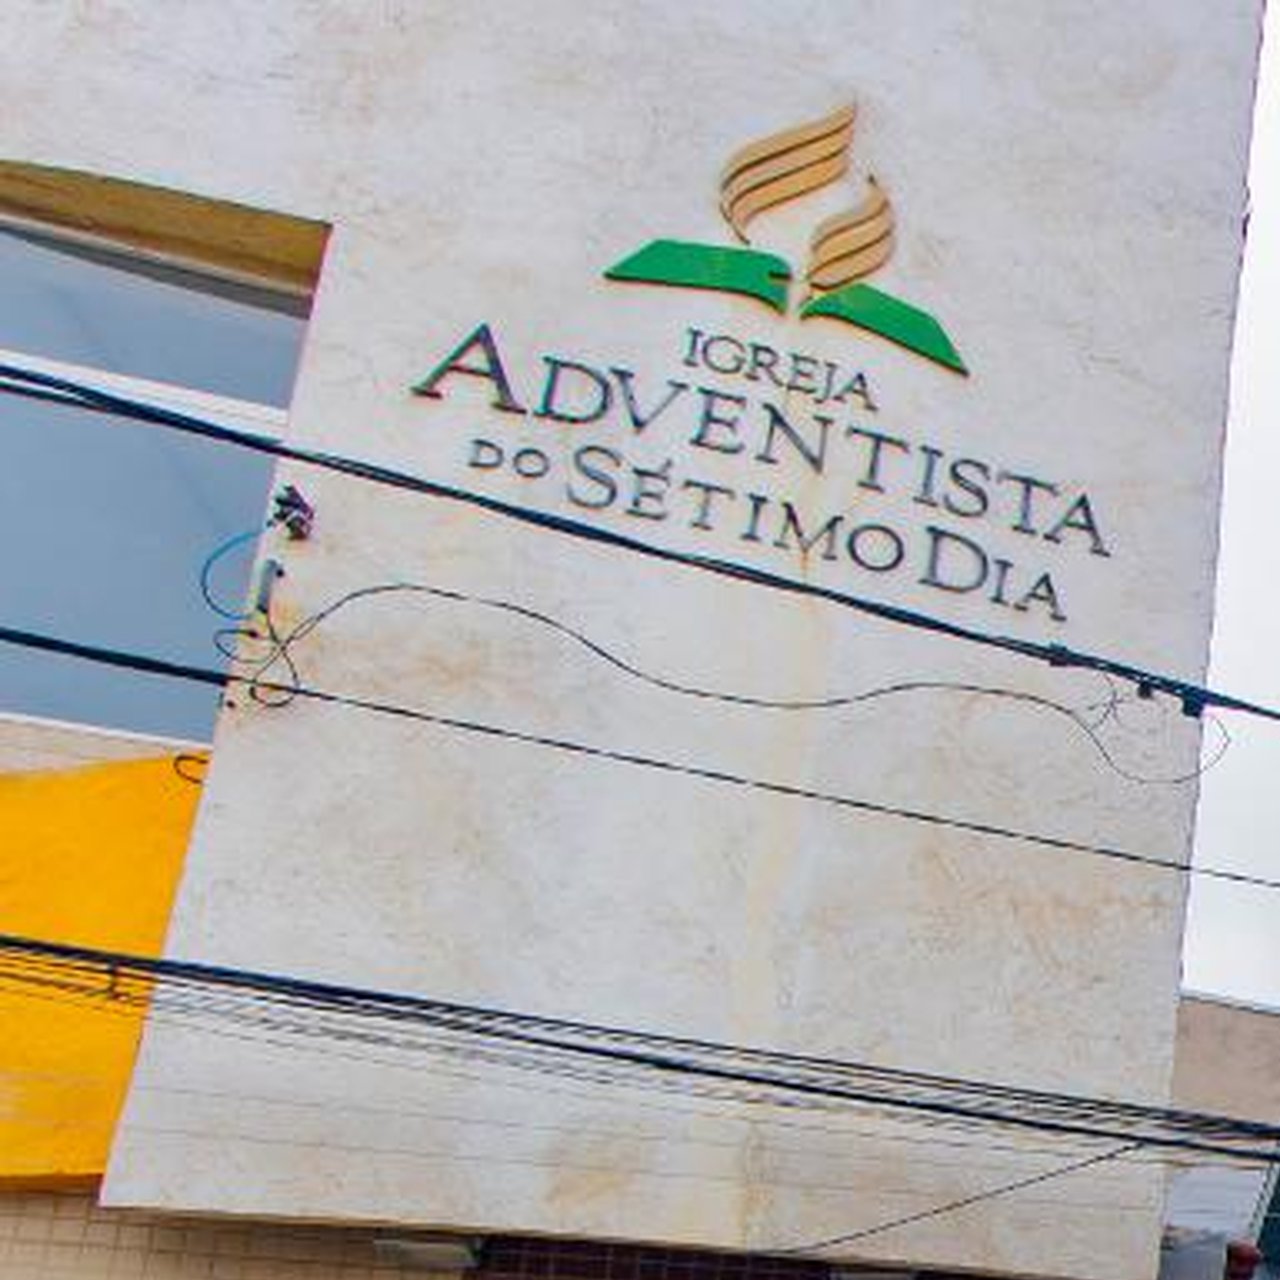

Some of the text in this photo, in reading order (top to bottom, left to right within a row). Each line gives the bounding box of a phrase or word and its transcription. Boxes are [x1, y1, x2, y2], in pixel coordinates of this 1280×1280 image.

[410, 322, 1112, 558] ADVENTISTA
[682, 326, 879, 411] IGREJA
[467, 438, 1068, 623] DO SÉTIMO DIA
